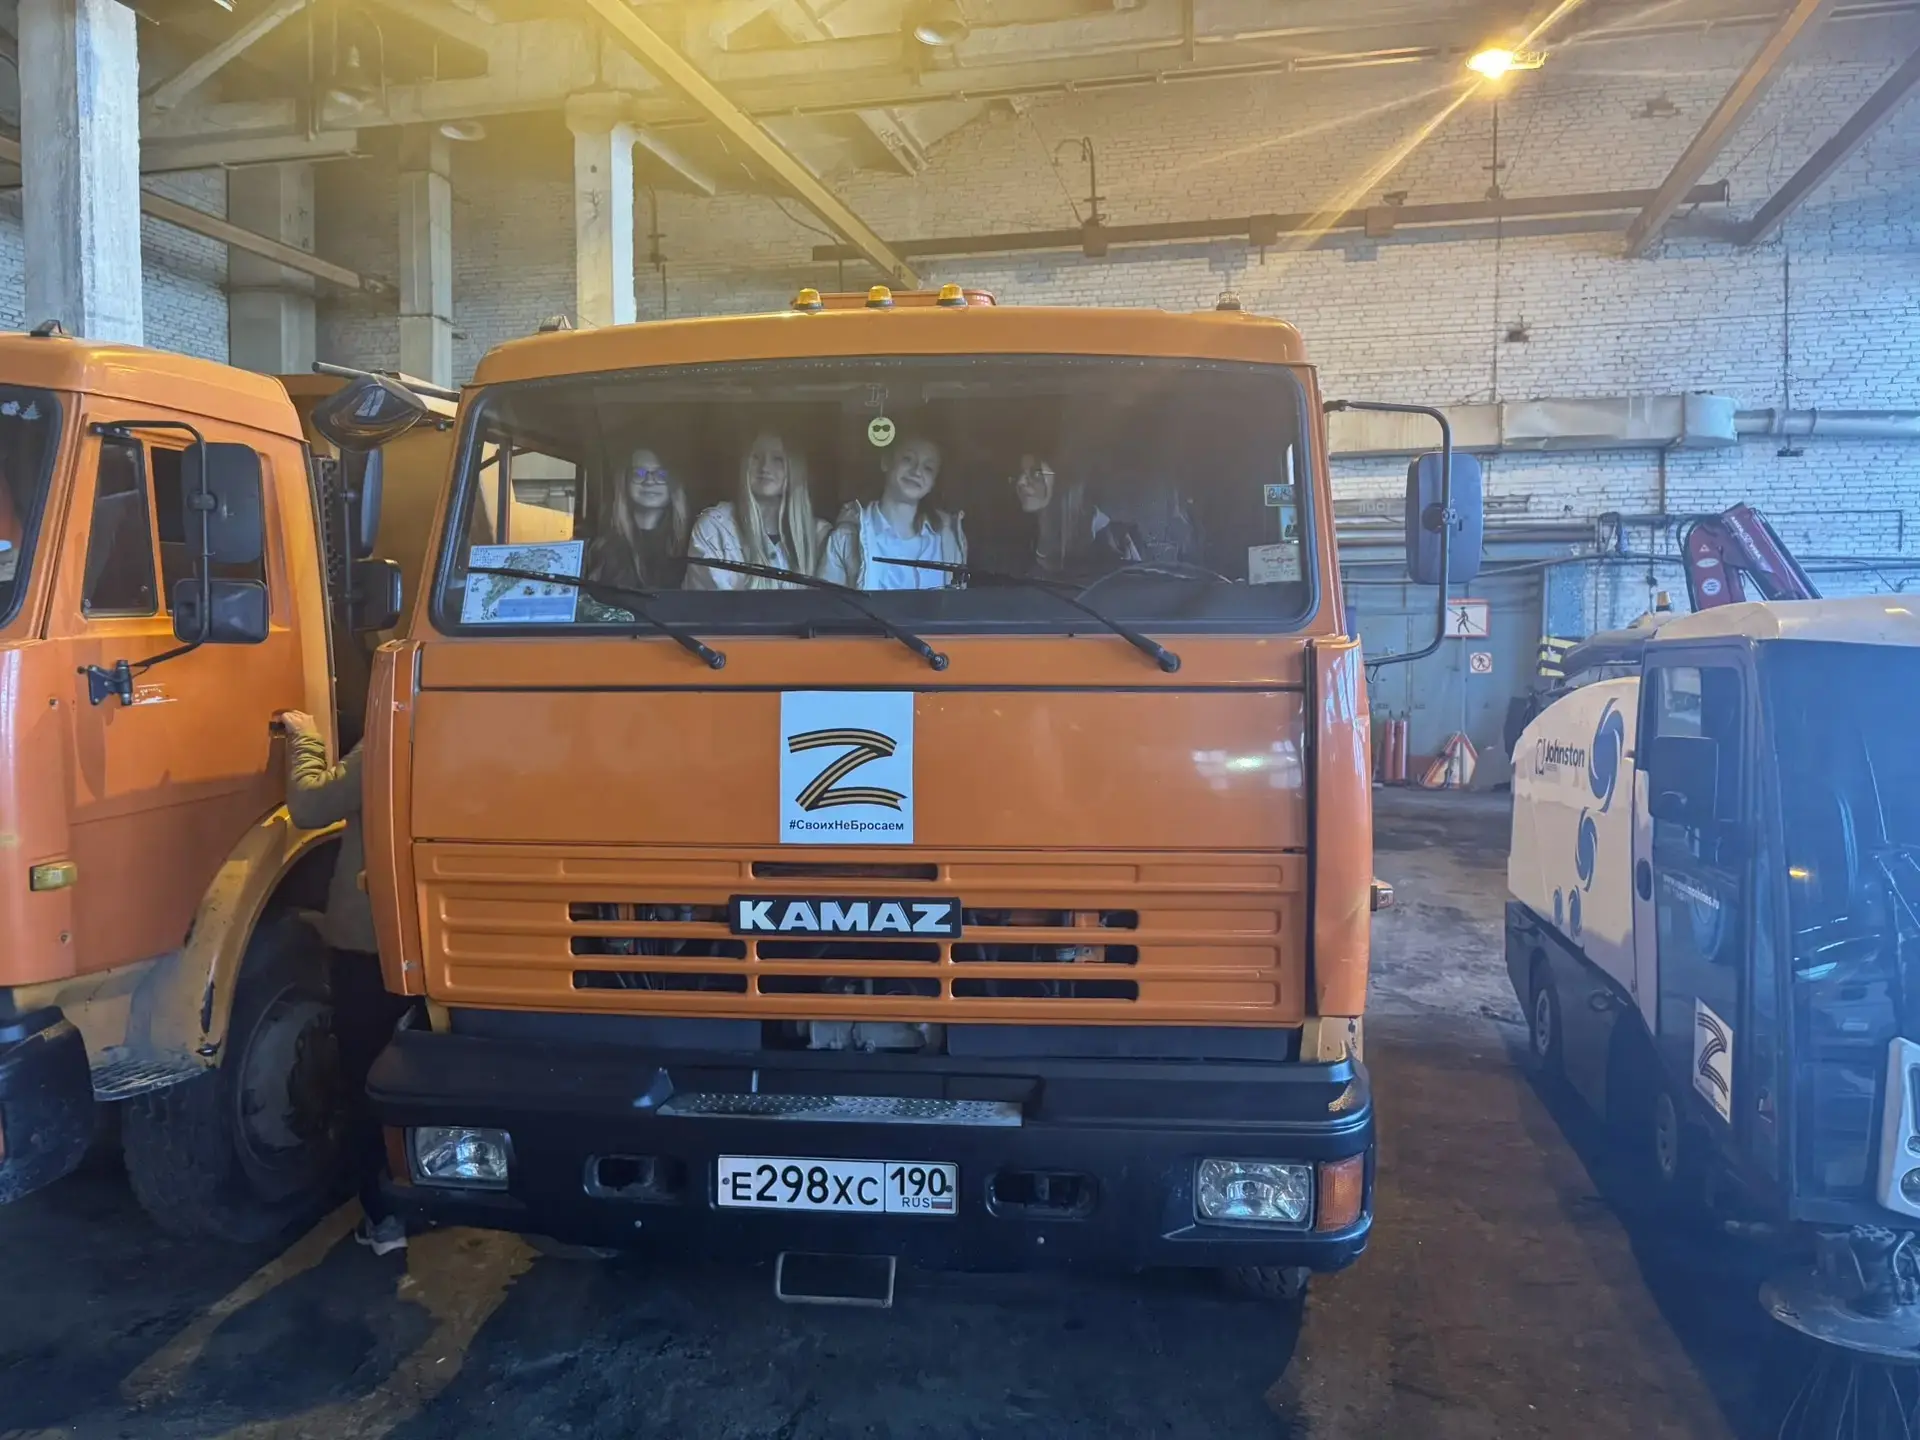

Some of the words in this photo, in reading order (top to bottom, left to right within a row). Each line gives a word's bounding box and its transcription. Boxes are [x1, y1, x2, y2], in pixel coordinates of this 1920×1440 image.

[1546, 739, 1585, 768] Johnston
[789, 819, 904, 832] #СвоихНеБросаем
[739, 900, 952, 933] KAMAZ
[890, 1166, 947, 1197] 190
[902, 1196, 930, 1208] RUS
